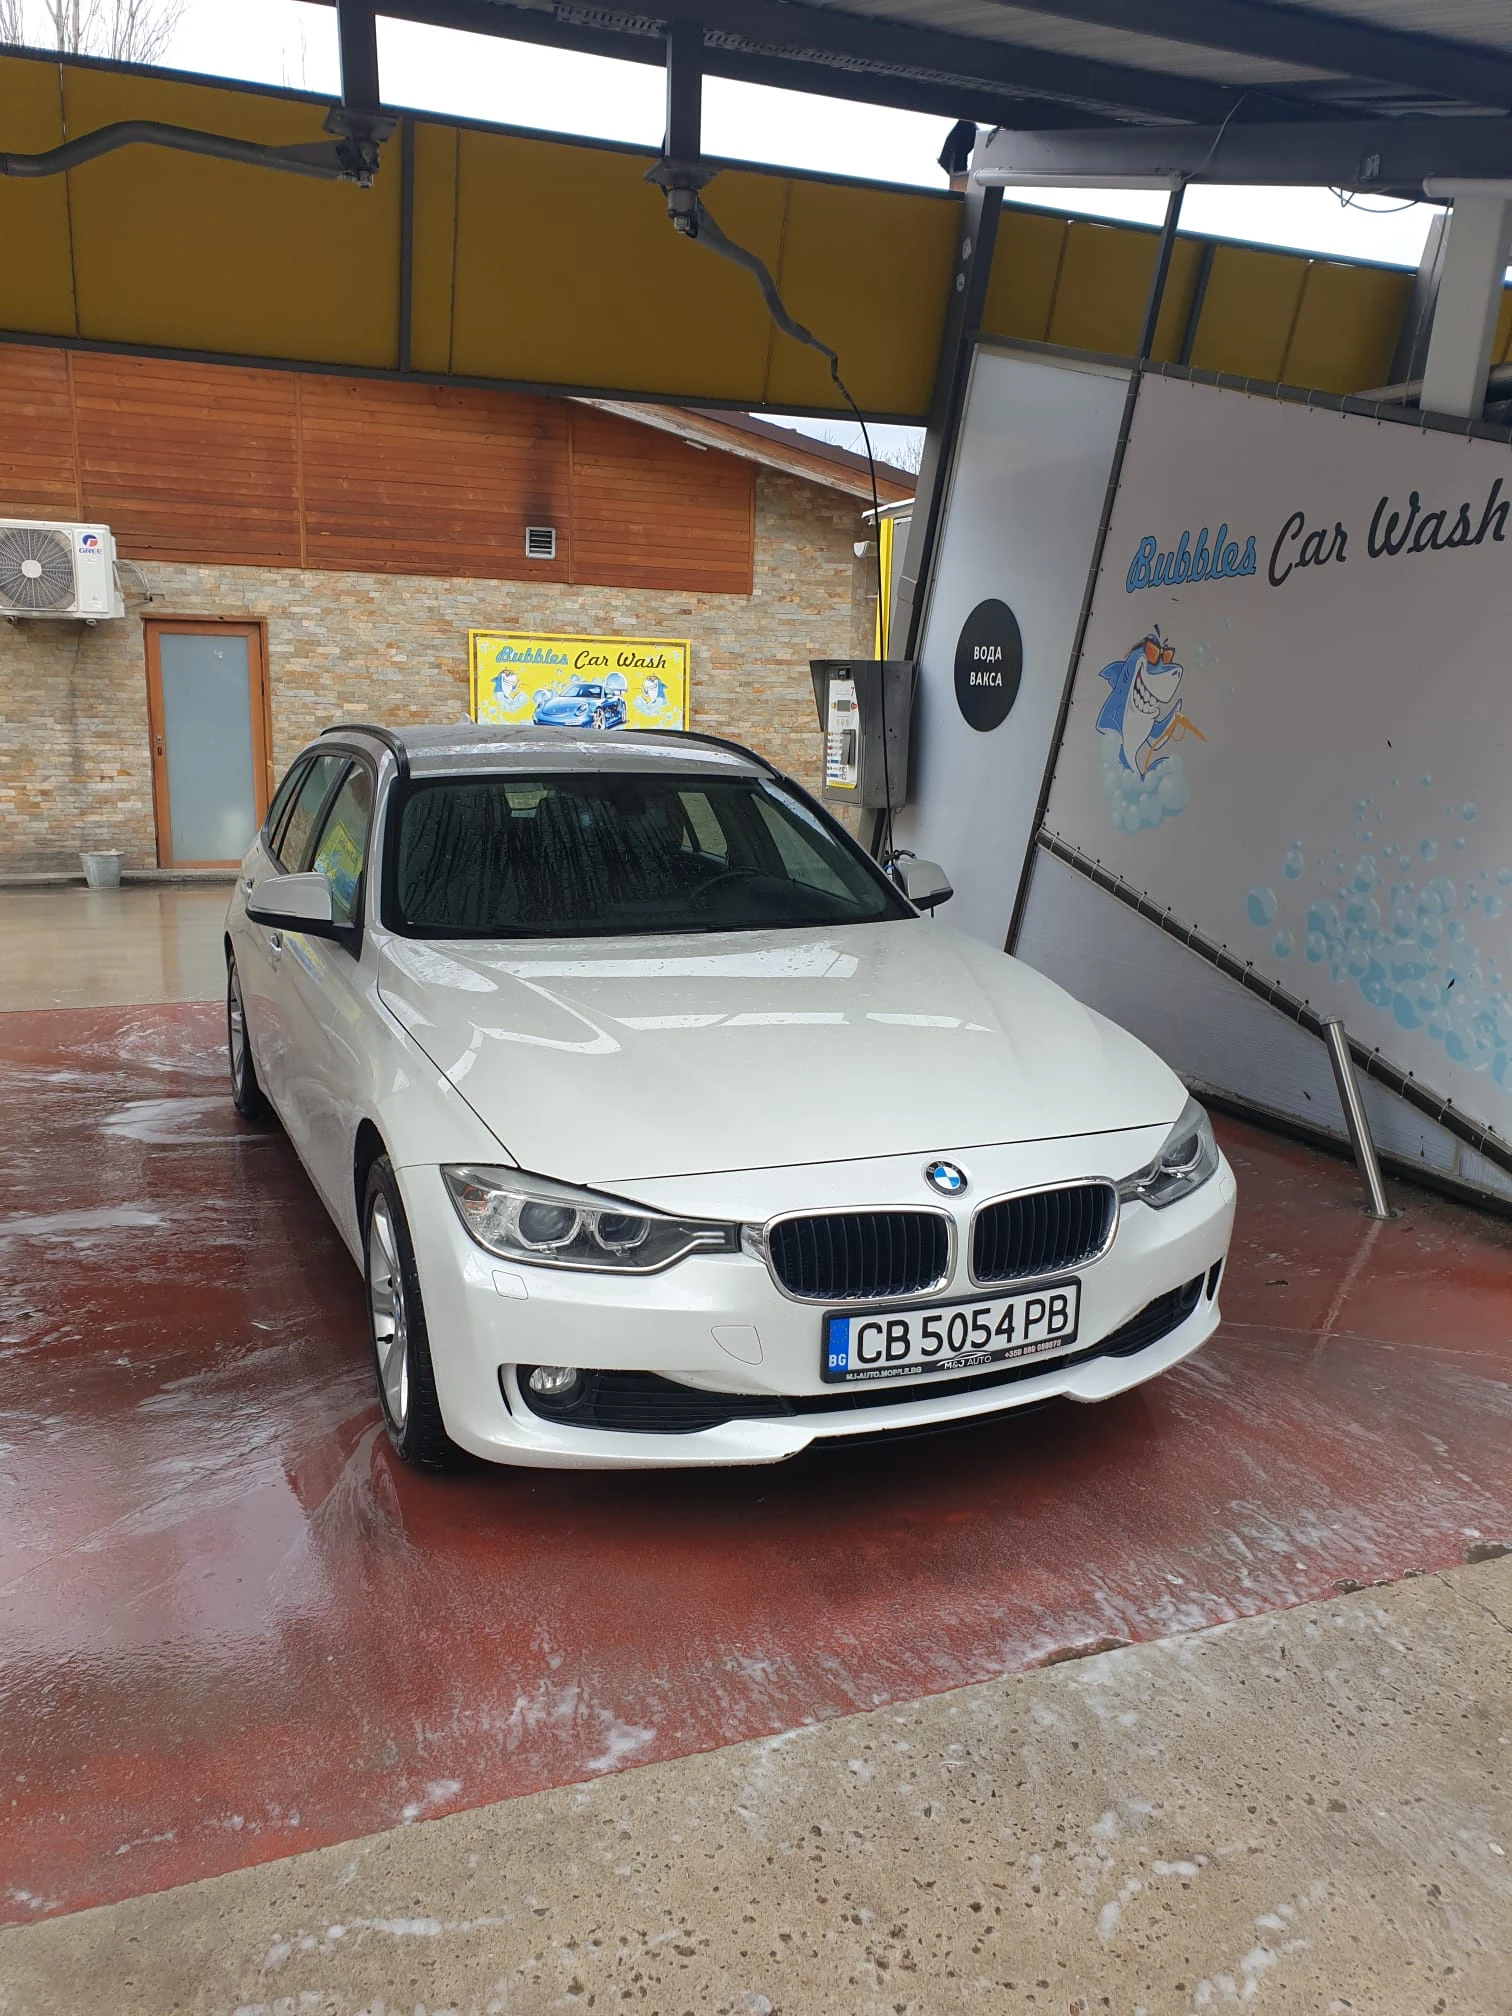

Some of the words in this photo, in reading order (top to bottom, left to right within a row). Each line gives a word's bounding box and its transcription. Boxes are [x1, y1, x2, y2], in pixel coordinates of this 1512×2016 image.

[1126, 523, 1256, 593] Bubbles
[1268, 511, 1347, 587] Car
[1367, 478, 1511, 558] Wash
[495, 645, 569, 665] Bubbles
[574, 650, 610, 669] Car
[616, 652, 667, 669] Wash
[973, 646, 1003, 663] ВОДА
[969, 671, 1003, 687] ВАКСА
[856, 1319, 911, 1365] CB
[920, 1303, 1016, 1356] 5054
[1022, 1293, 1069, 1341] PB
[828, 1354, 847, 1368] BG
[943, 1359, 965, 1370] M&J
[966, 1355, 993, 1367] AUTO
